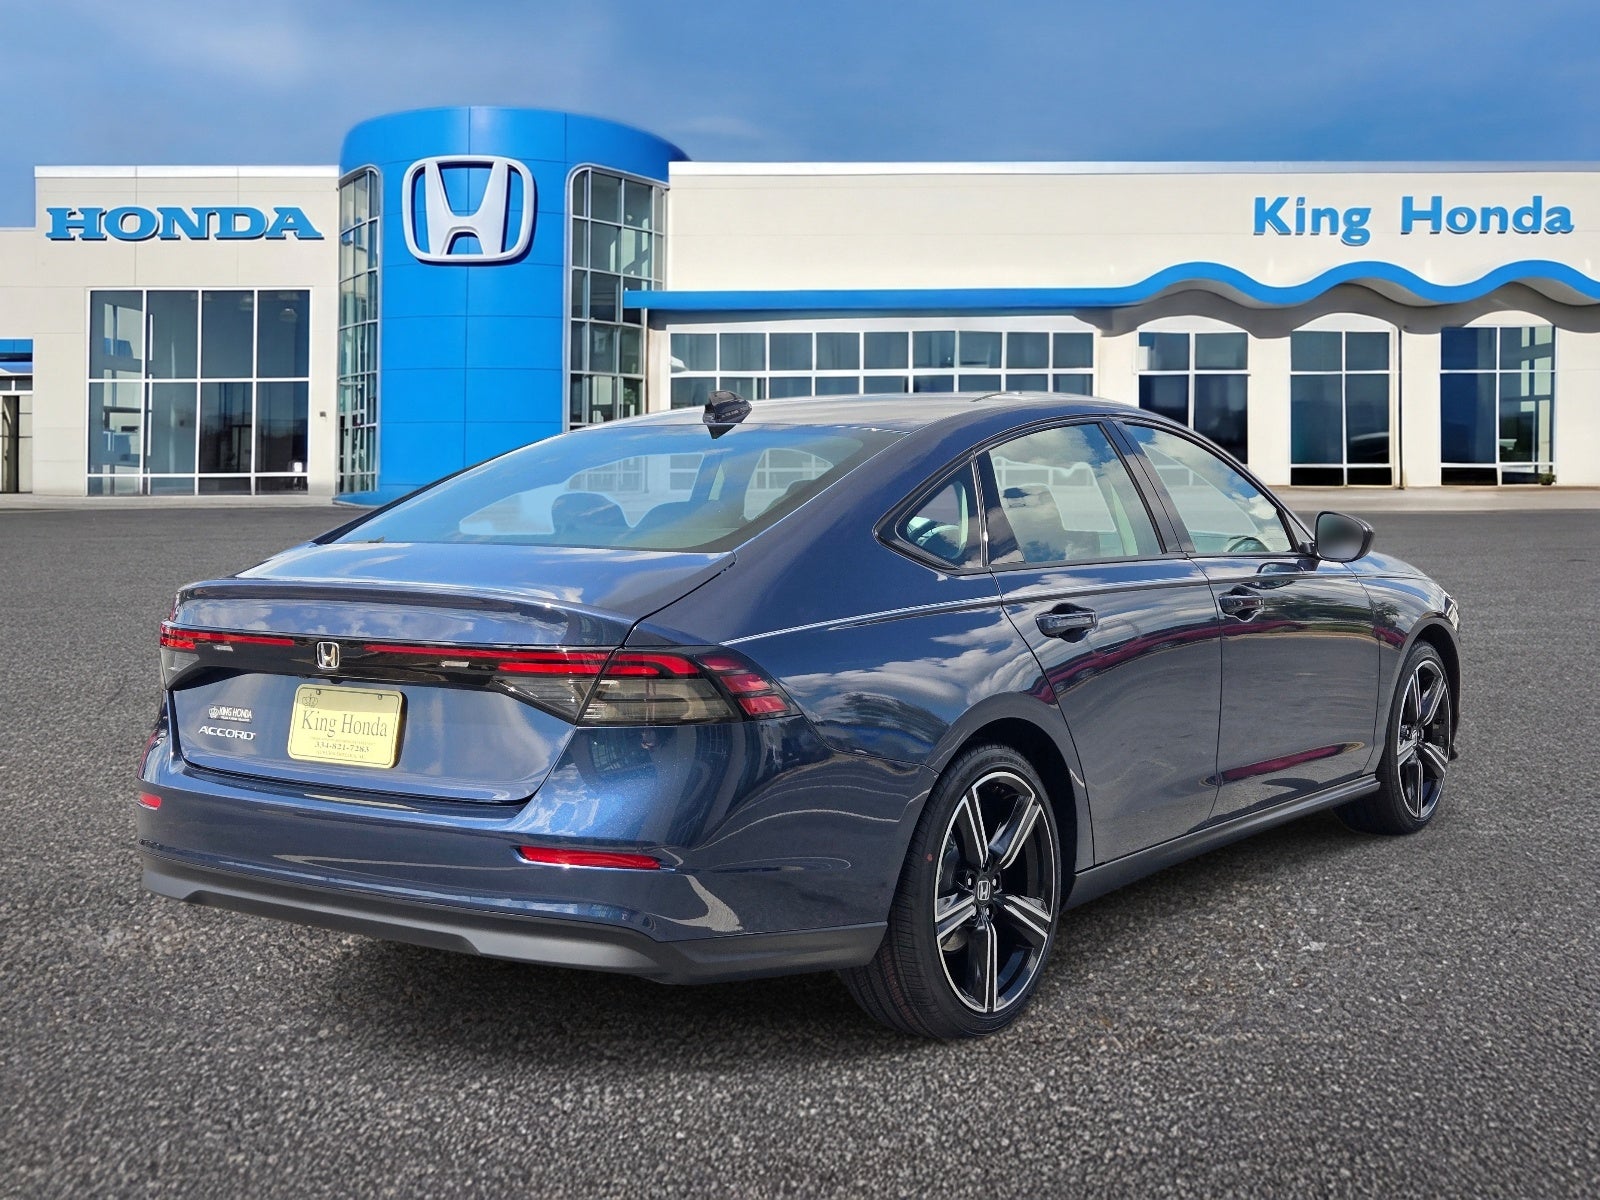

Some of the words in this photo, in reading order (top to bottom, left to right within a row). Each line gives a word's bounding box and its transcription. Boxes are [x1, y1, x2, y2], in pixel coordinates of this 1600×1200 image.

[45, 206, 324, 241] HONDA
[1253, 196, 1371, 246] King
[1400, 195, 1575, 235] Honda
[219, 706, 233, 716] KING
[232, 708, 252, 719] HONDA
[198, 725, 255, 741] ACCORD
[302, 710, 335, 738] King
[341, 713, 387, 737] Honda
[314, 741, 370, 753] 334-821-7283
